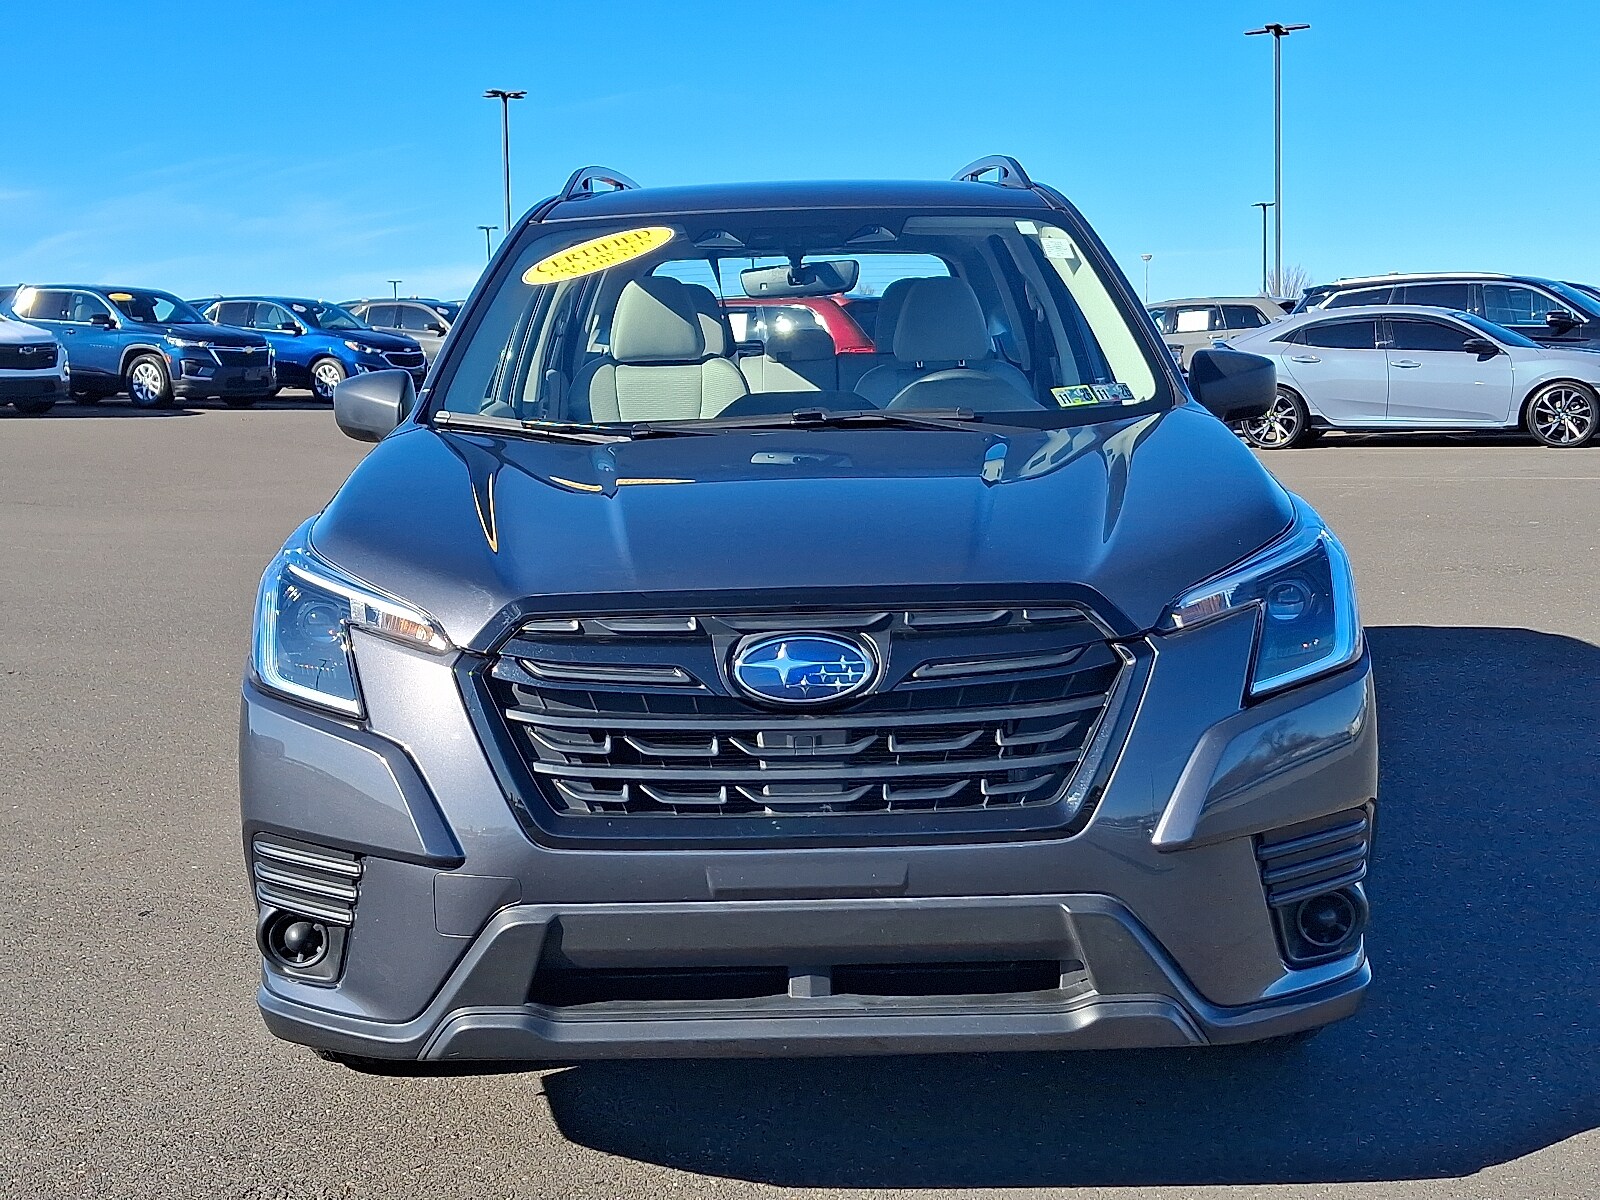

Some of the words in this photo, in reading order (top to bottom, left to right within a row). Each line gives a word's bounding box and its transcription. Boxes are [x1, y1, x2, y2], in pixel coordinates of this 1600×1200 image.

[535, 230, 651, 273] CERTIFIED
[1058, 393, 1072, 405] 11
[1095, 388, 1110, 400] 11
